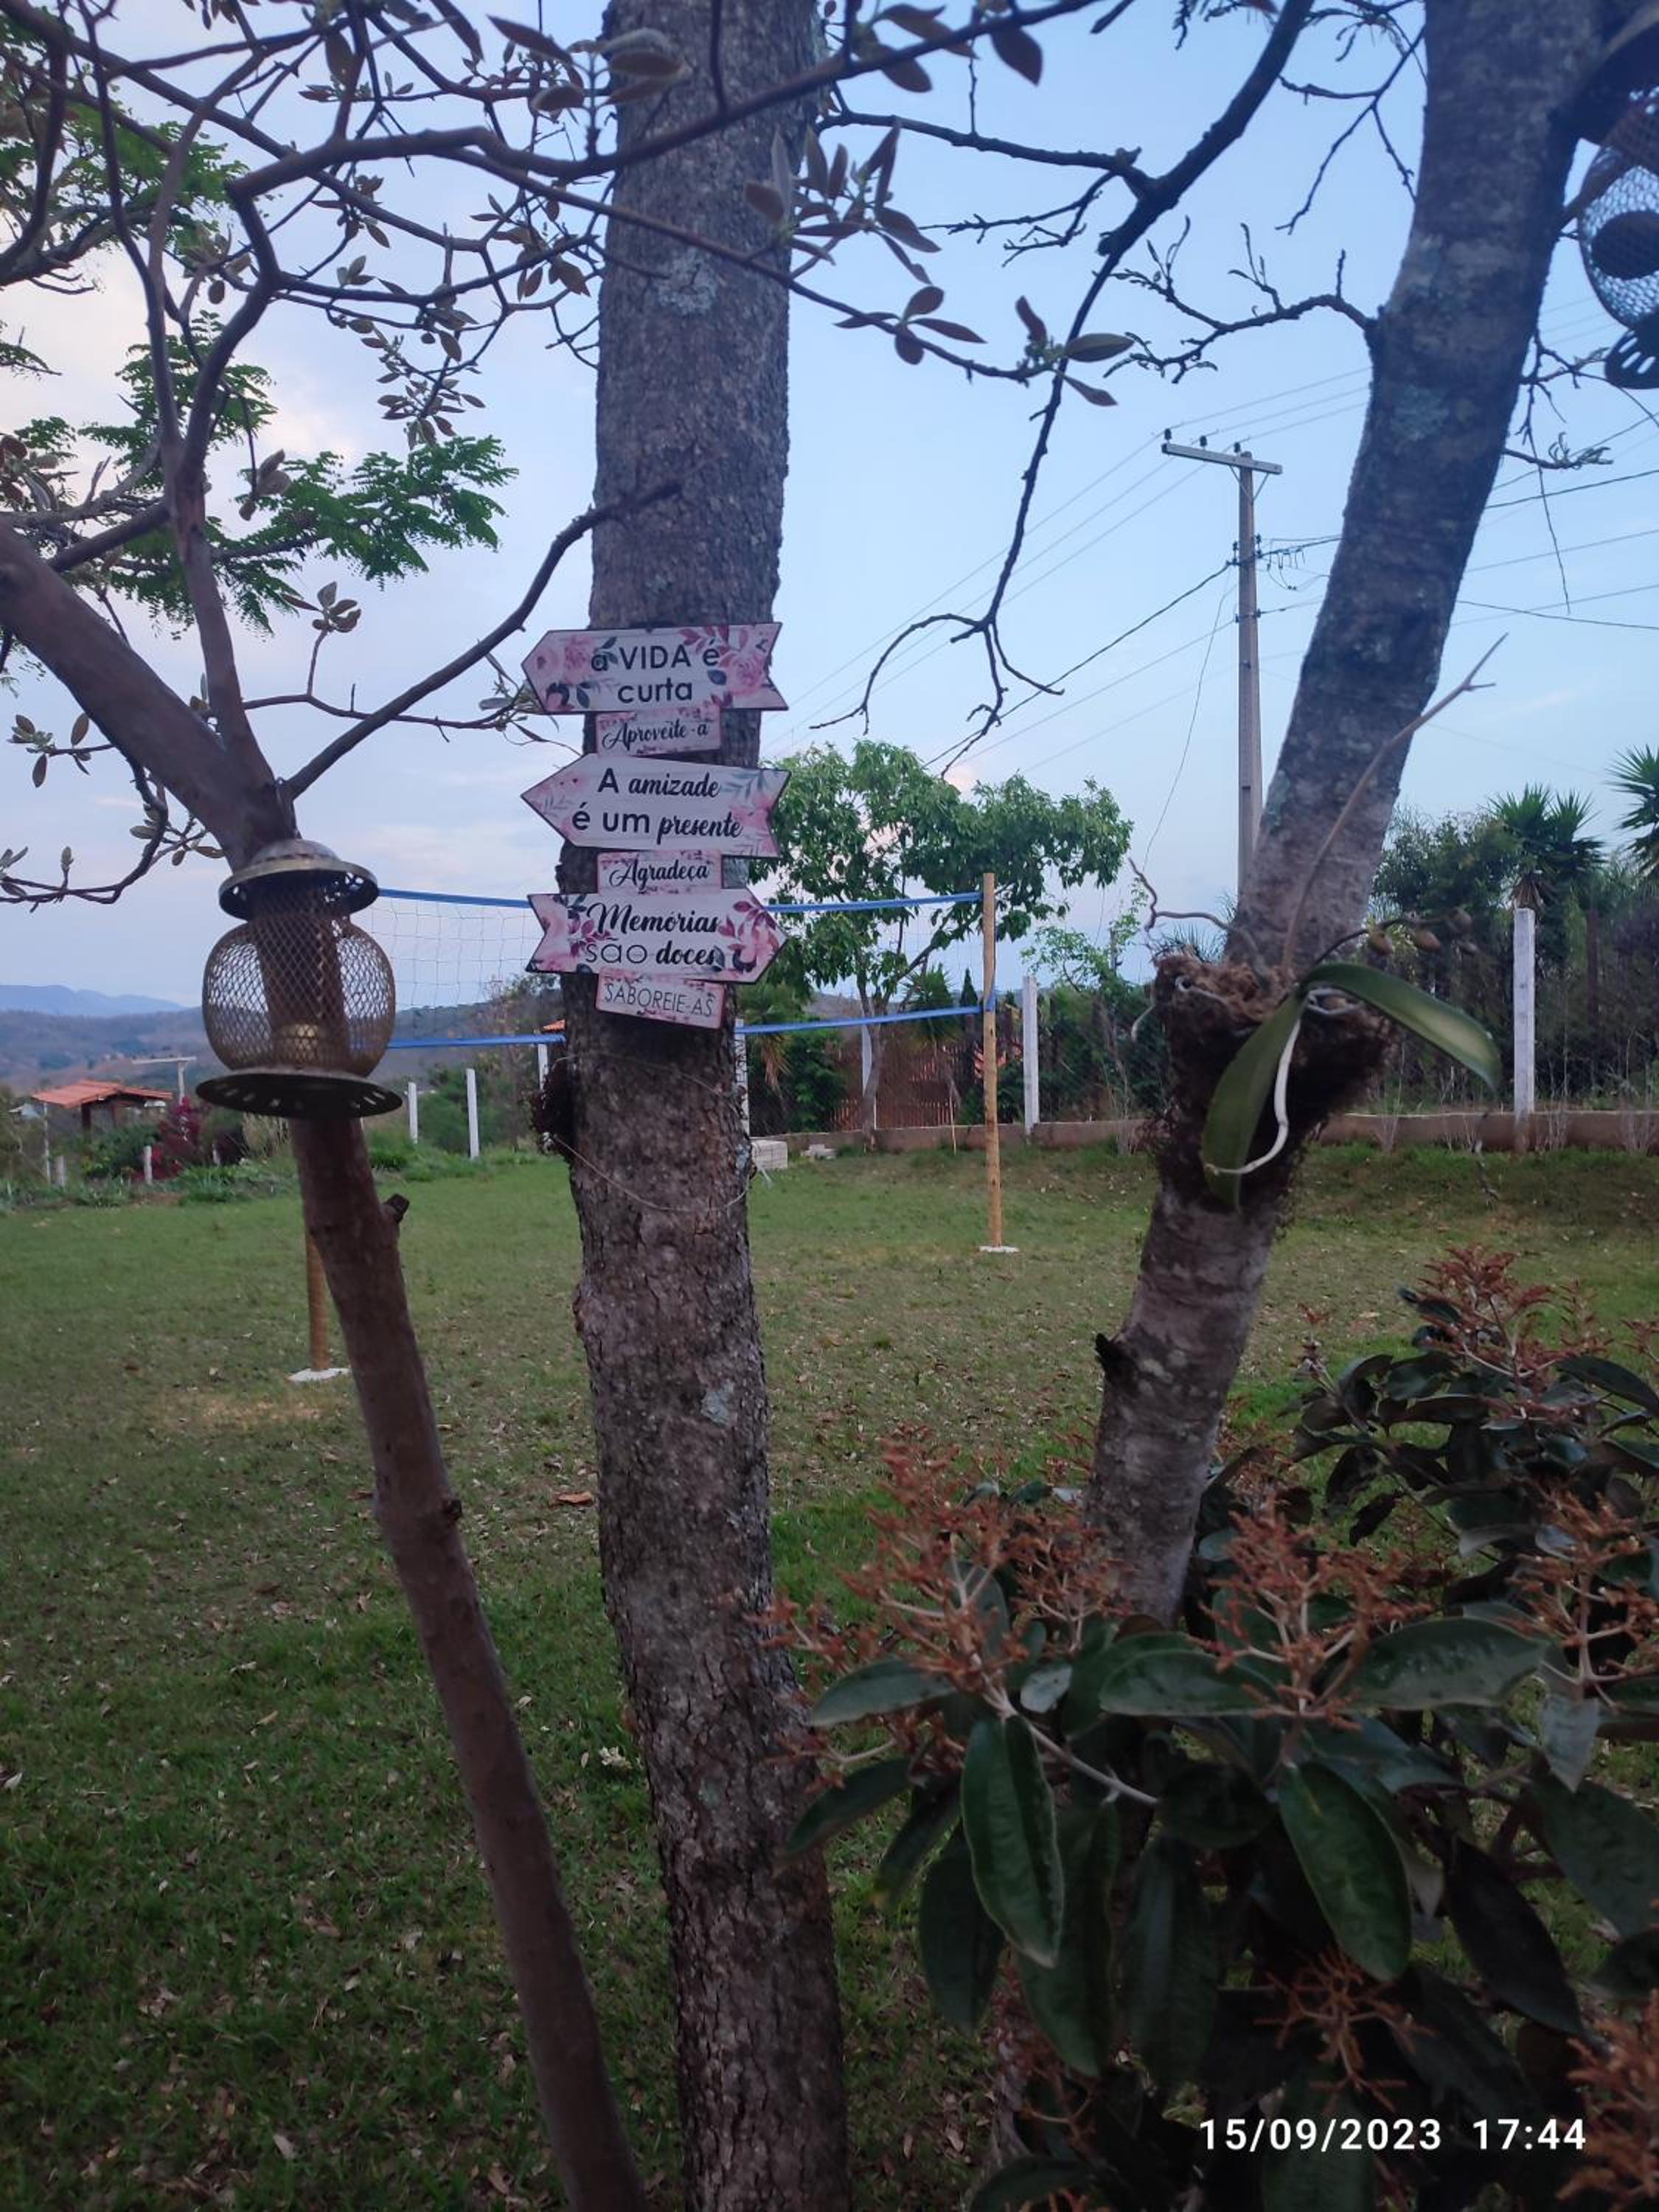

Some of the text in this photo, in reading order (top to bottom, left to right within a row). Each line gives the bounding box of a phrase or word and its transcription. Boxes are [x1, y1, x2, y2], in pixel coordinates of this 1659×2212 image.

[619, 644, 692, 670] VIDA
[703, 639, 720, 666] é
[617, 678, 692, 704] curta
[597, 768, 720, 798] A amizade
[571, 801, 743, 845] é um presente
[608, 859, 710, 891] Agradeça
[586, 902, 720, 934] Memórias
[585, 937, 715, 966] são doces
[604, 982, 715, 1018] SABOREIE-AS
